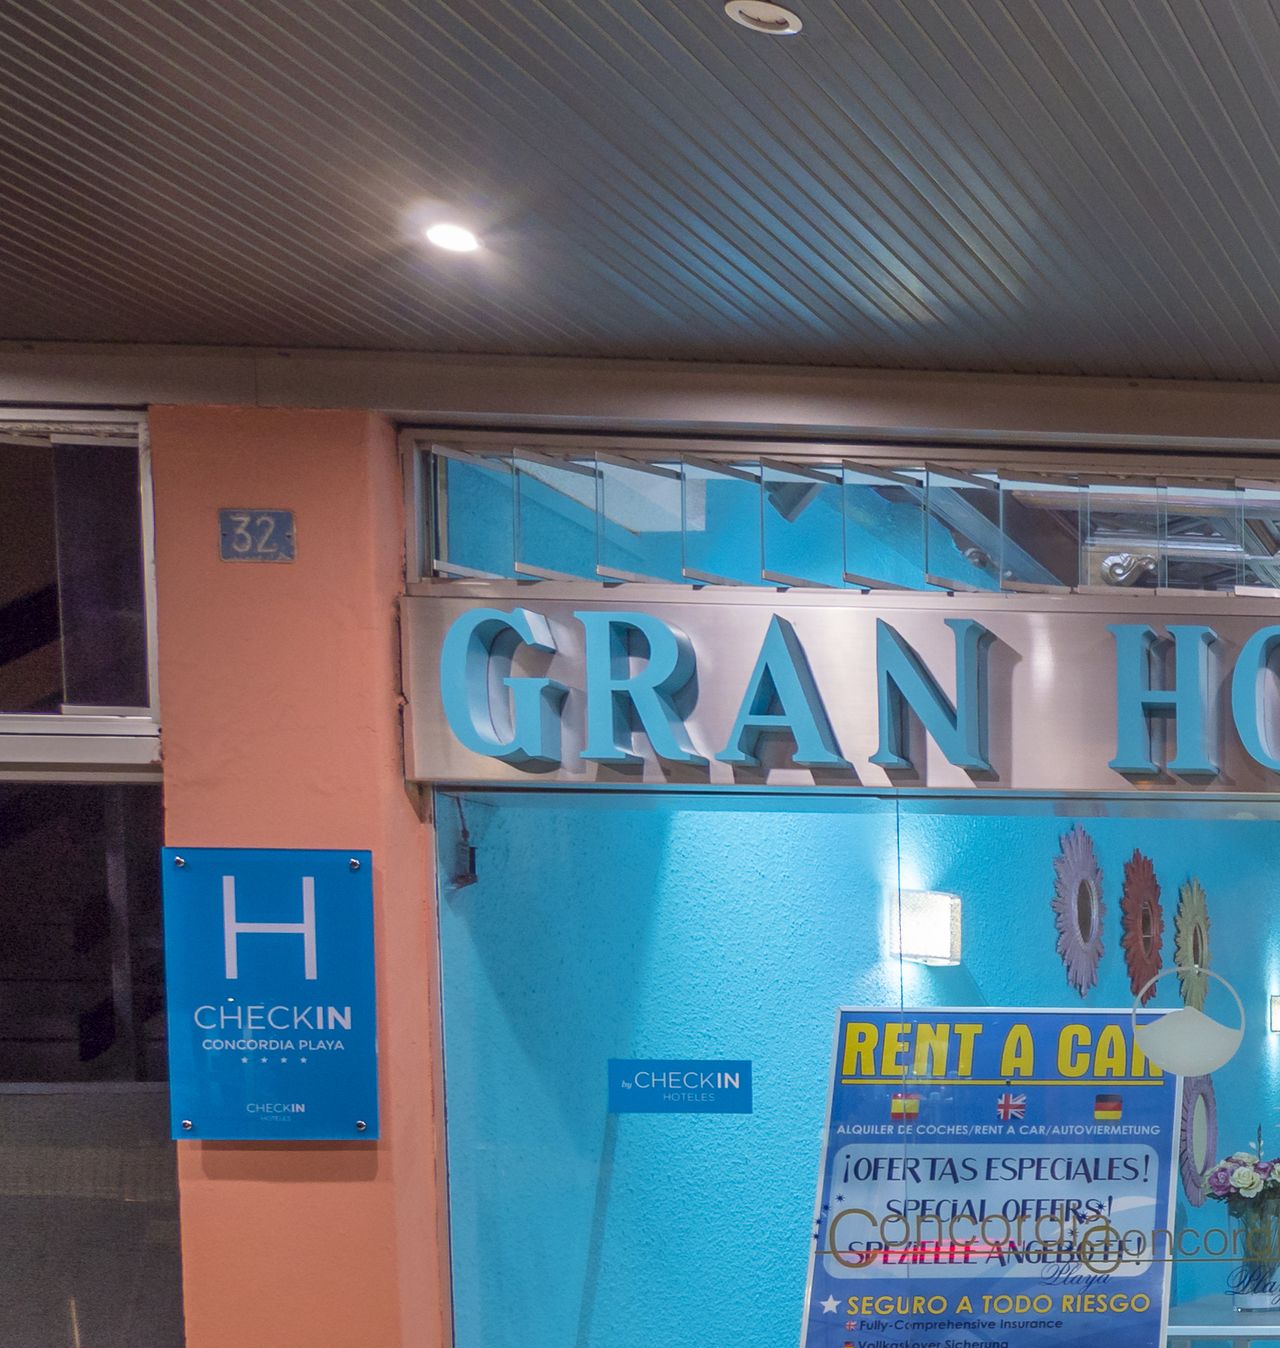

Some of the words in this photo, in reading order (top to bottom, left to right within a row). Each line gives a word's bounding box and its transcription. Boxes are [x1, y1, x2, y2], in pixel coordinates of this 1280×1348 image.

[229, 515, 278, 552] 32
[440, 607, 998, 781] GRAN
[222, 875, 318, 980] H
[194, 1005, 352, 1030] CHECKIN
[202, 1039, 295, 1050] CONCORDIA
[299, 1040, 344, 1050] PLAYA
[841, 1022, 983, 1078] RENT
[1000, 1024, 1035, 1078] A
[634, 1071, 740, 1089] CHECKIN
[246, 1103, 305, 1113] CHECKIN
[664, 1093, 716, 1102] HOTELES
[836, 1125, 894, 1136] ALQUILER
[898, 1125, 912, 1136] DE
[916, 1125, 1003, 1136] COCHES/RENT
[1006, 1125, 1015, 1135] A
[1019, 1125, 1161, 1136] CAR/AUTOVIERMETUNG
[829, 1202, 1111, 1269] Concordia
[1041, 1262, 1112, 1295] Playa
[846, 1296, 948, 1316] SEGURO
[955, 1296, 974, 1314] A
[981, 1295, 1061, 1314] TODO
[1061, 1293, 1151, 1313] RIESGO
[859, 1319, 996, 1332] Fully-Comprehensive
[1000, 1319, 1064, 1330] Insurance
